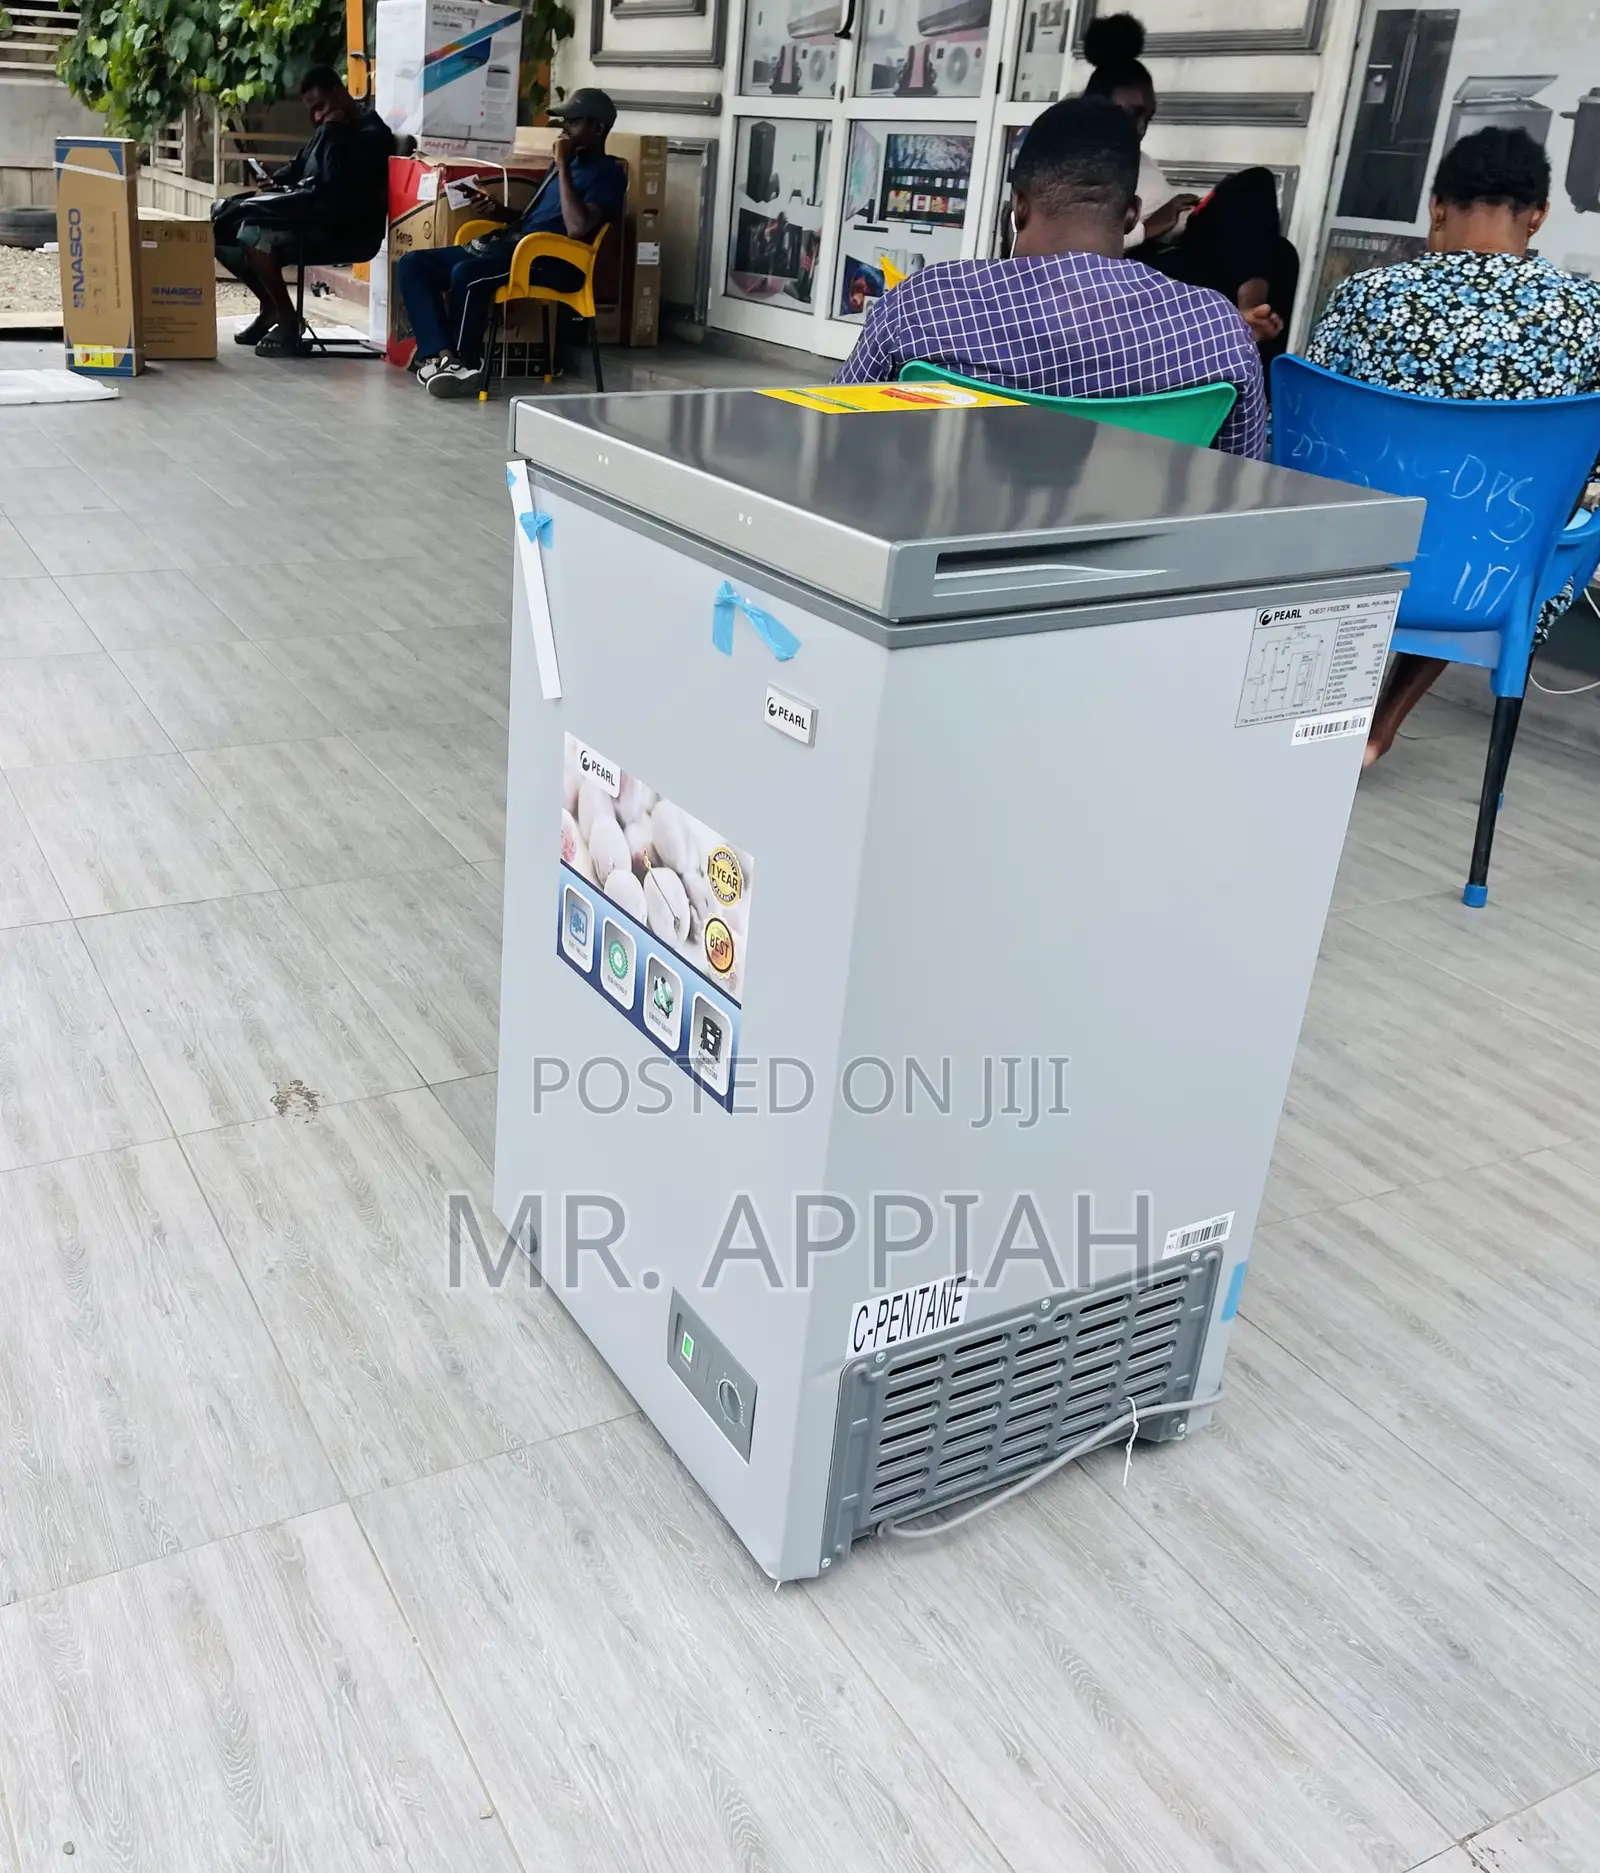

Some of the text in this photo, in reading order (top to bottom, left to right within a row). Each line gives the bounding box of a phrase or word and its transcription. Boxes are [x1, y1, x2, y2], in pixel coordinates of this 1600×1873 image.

[68, 207, 85, 291] NASCO
[161, 286, 203, 296] NASCO
[1273, 609, 1302, 622] PEARL
[1308, 606, 1327, 616] CHEST
[1327, 603, 1351, 614] FREEZER
[778, 705, 808, 730] PEARL
[591, 760, 616, 787] PEARL
[711, 863, 739, 891] 1 YEAR
[709, 933, 730, 960] BEST
[853, 1276, 967, 1353] C-PENTANE
